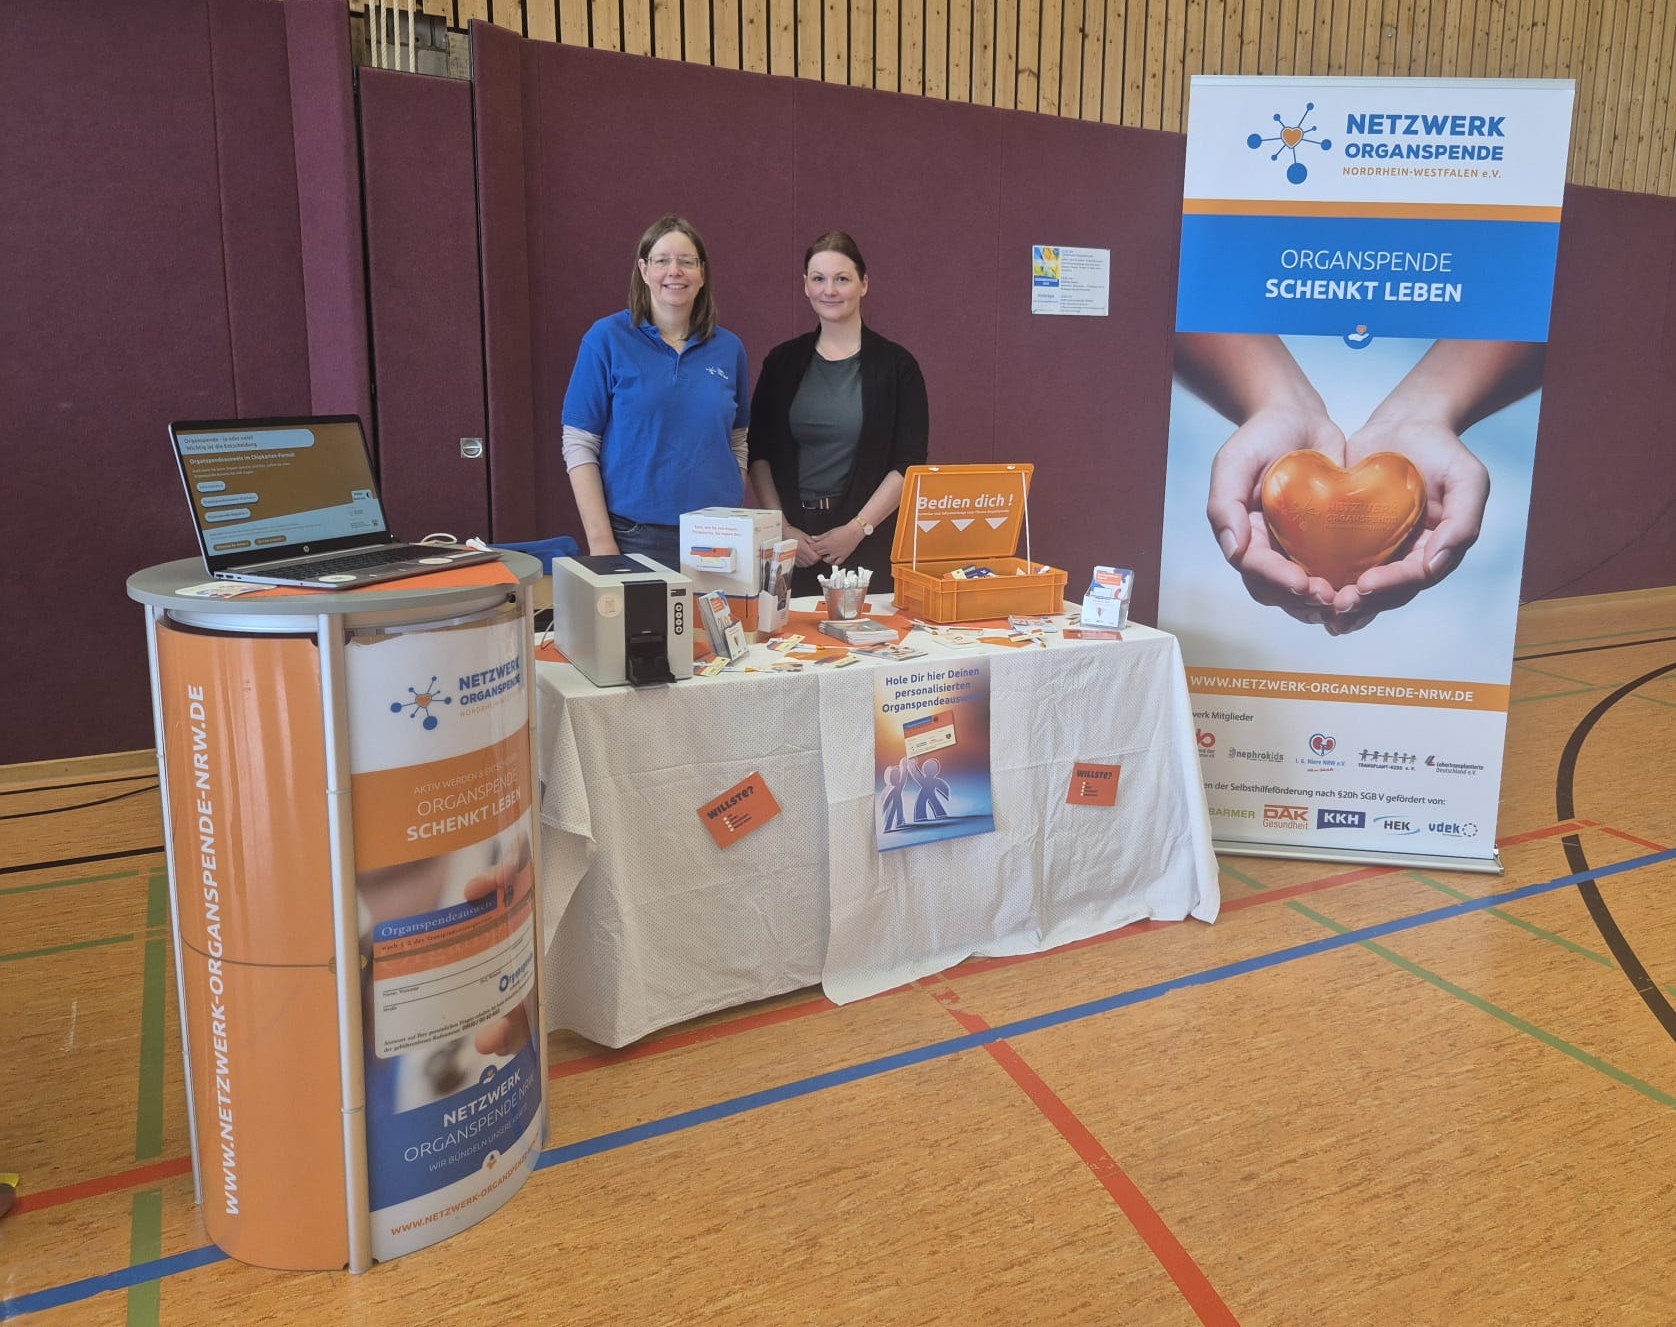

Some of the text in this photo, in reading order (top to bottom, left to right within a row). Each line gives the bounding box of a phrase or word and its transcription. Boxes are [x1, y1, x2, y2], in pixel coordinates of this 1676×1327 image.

[1346, 114, 1505, 138] NETZWERK
[1344, 143, 1504, 162] ORGANSPENDE
[1342, 166, 1502, 178] NORDRHEIN-WESTFALEN e.V.
[1280, 249, 1452, 272] ORGANSPENDE
[1265, 279, 1462, 303] SCHENKT LEBEN
[918, 495, 970, 510] Bedien
[974, 493, 1005, 508] dich
[459, 656, 520, 691] NETZWERK
[886, 668, 980, 686] Hole Dir hier Deinen
[895, 682, 972, 700] personalisierten
[1190, 675, 1474, 702] WWW.NETZWERK-ORGANSPENDE-NRW.DE
[1212, 712, 1254, 722] Mitglieder
[1236, 750, 1284, 761] nephrokids
[1214, 782, 1228, 790] der
[1230, 782, 1314, 798] Selbsthilfeförderung
[1316, 790, 1336, 798] nach
[1338, 790, 1358, 800] §20h
[1360, 792, 1377, 800] SGB
[1386, 794, 1426, 804] gefördert
[406, 786, 522, 842] SCHENKT LEBEN
[1208, 808, 1256, 818] BARMER
[1264, 804, 1308, 821] DAK
[1324, 812, 1360, 825] KKH
[1263, 818, 1308, 830] Gesundheit
[1384, 820, 1410, 831] HEK
[1428, 822, 1460, 834] vdek
[188, 685, 240, 1215] WWW.NETZWERK-ORGANSPENDE-NRW.DE
[443, 1068, 520, 1128] NETZWERK
[404, 1093, 517, 1162] ORGANSPENDE
[429, 1160, 446, 1172] WIR
